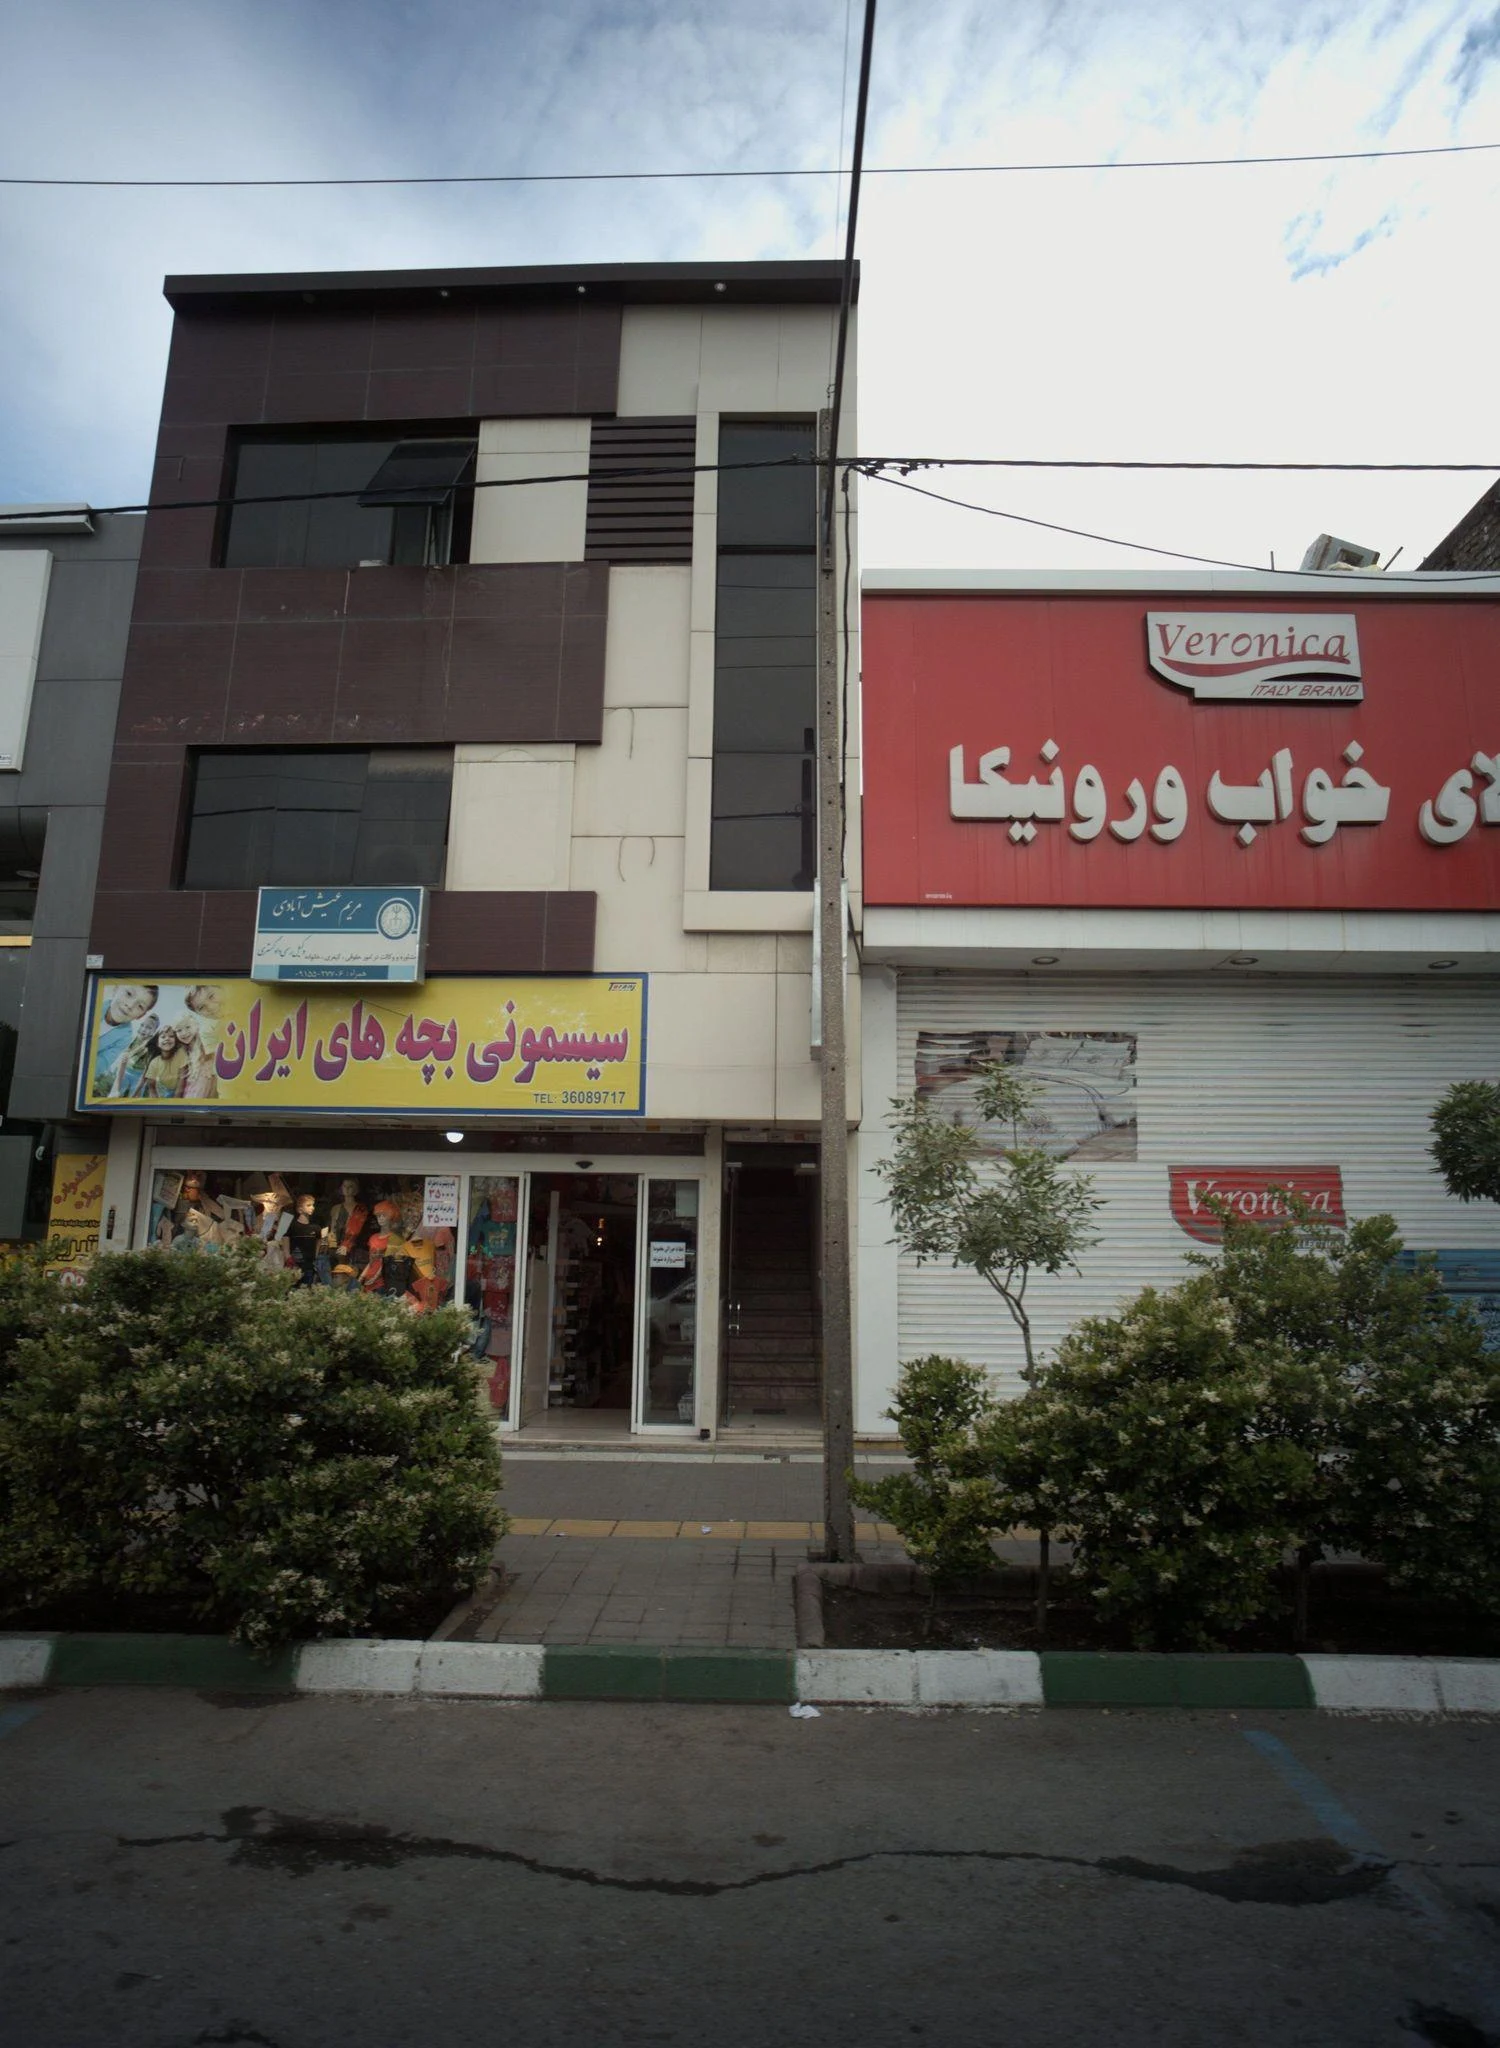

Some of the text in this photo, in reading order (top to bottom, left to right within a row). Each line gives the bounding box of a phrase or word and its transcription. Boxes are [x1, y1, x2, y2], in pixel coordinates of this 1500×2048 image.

[1155, 626, 1351, 658] Veronica
[1251, 684, 1360, 697] ITALY BRAND
[949, 738, 1189, 846] ورونیکا
[1208, 740, 1391, 848] خواب
[338, 900, 362, 929] مریم
[213, 999, 629, 1085] سیسمونی بچه های ایران
[533, 1091, 626, 1104] TEL: 36089717
